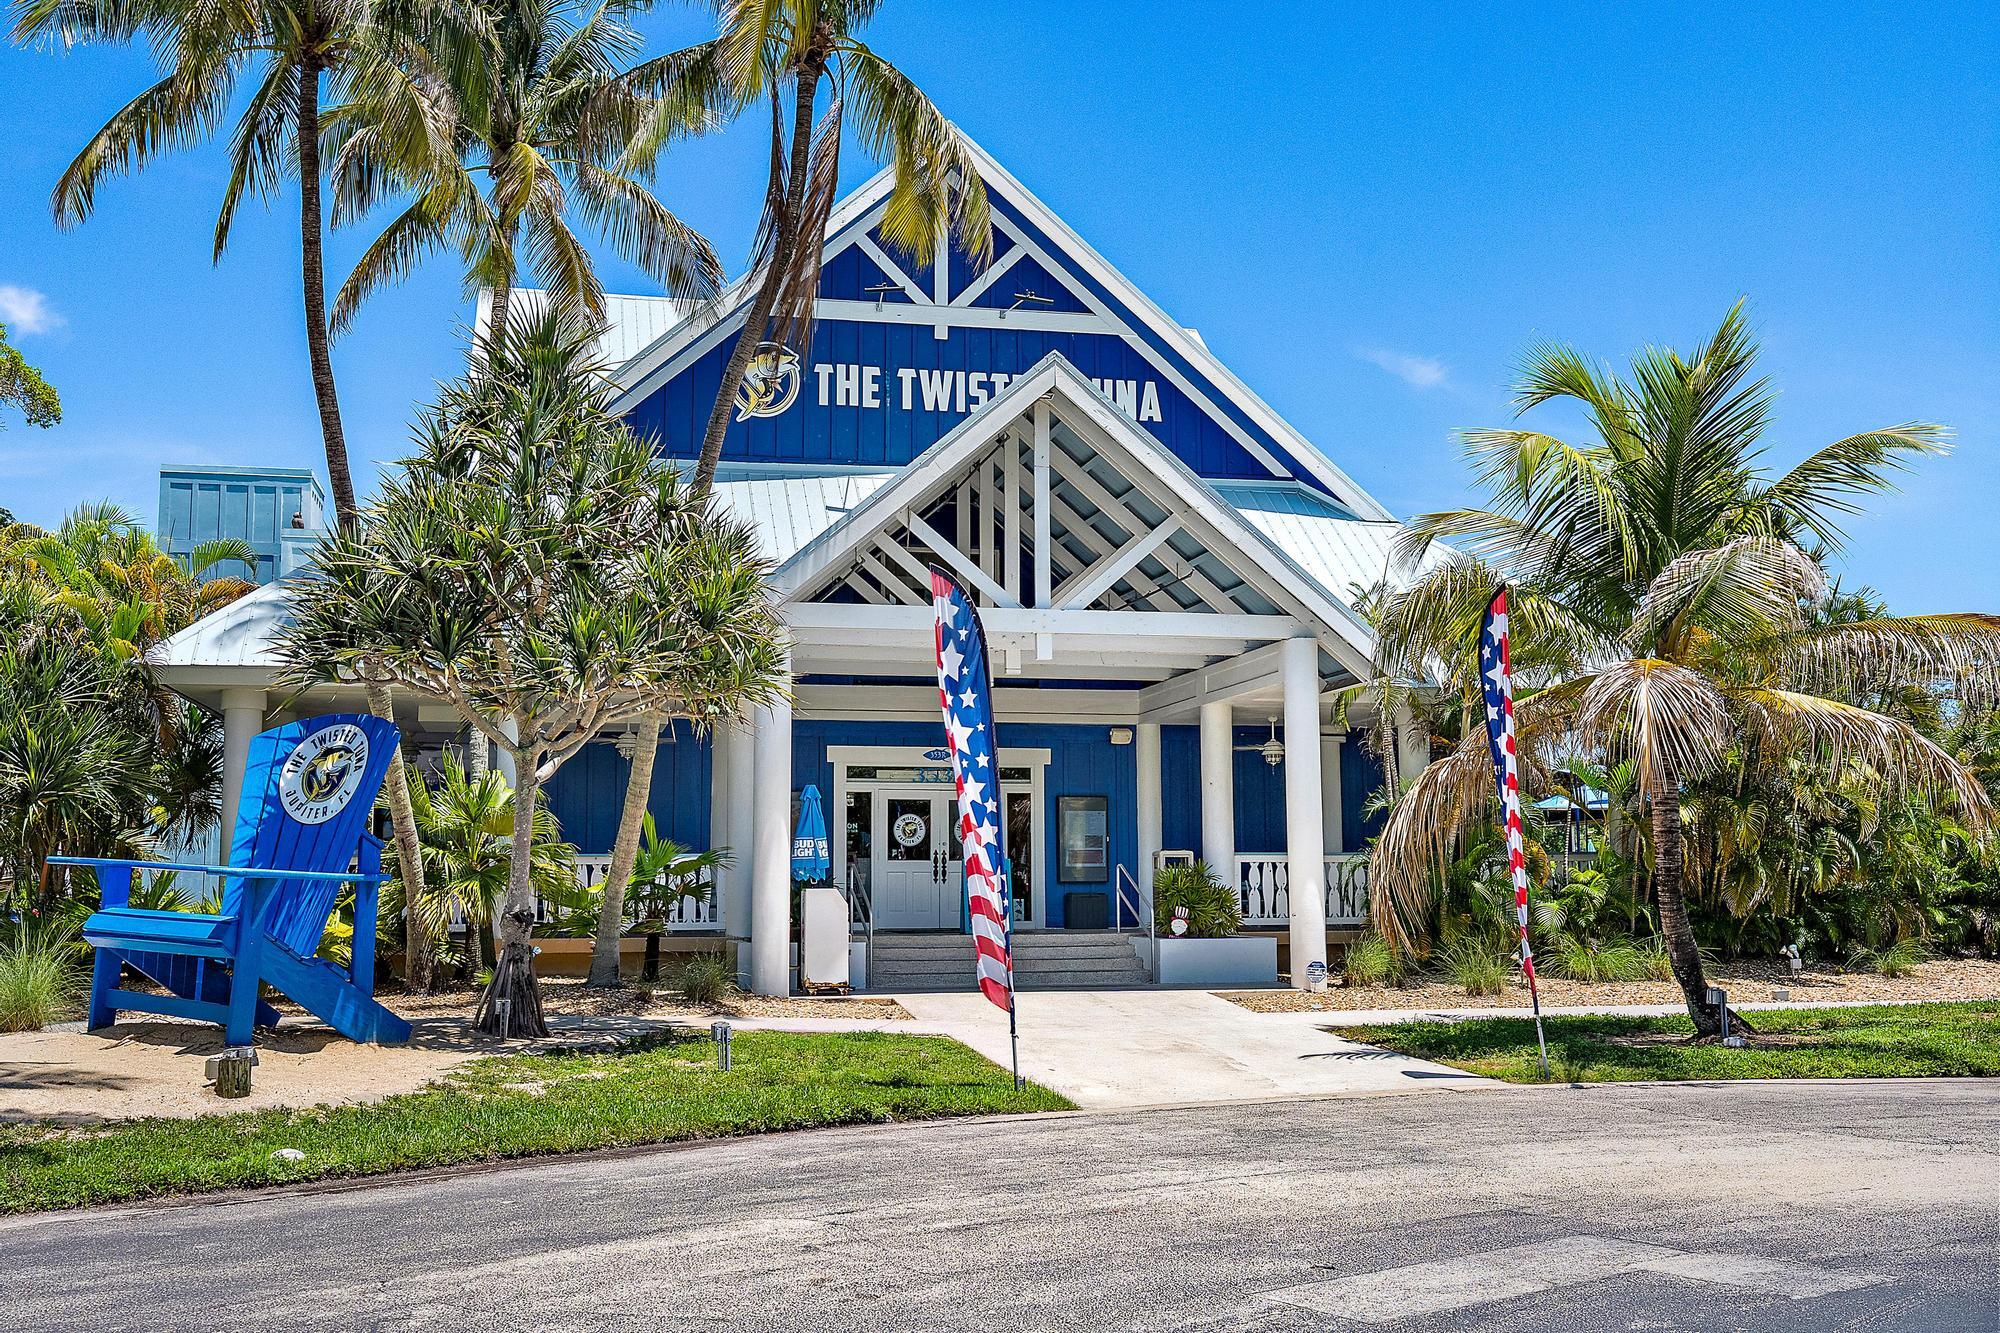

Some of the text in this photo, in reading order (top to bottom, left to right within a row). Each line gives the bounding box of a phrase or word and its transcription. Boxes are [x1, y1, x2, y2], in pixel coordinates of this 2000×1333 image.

[813, 363, 881, 409] THE
[287, 729, 366, 774] THE TWISTED TUNA
[338, 789, 351, 805] FL
[794, 839, 815, 849] BUD
